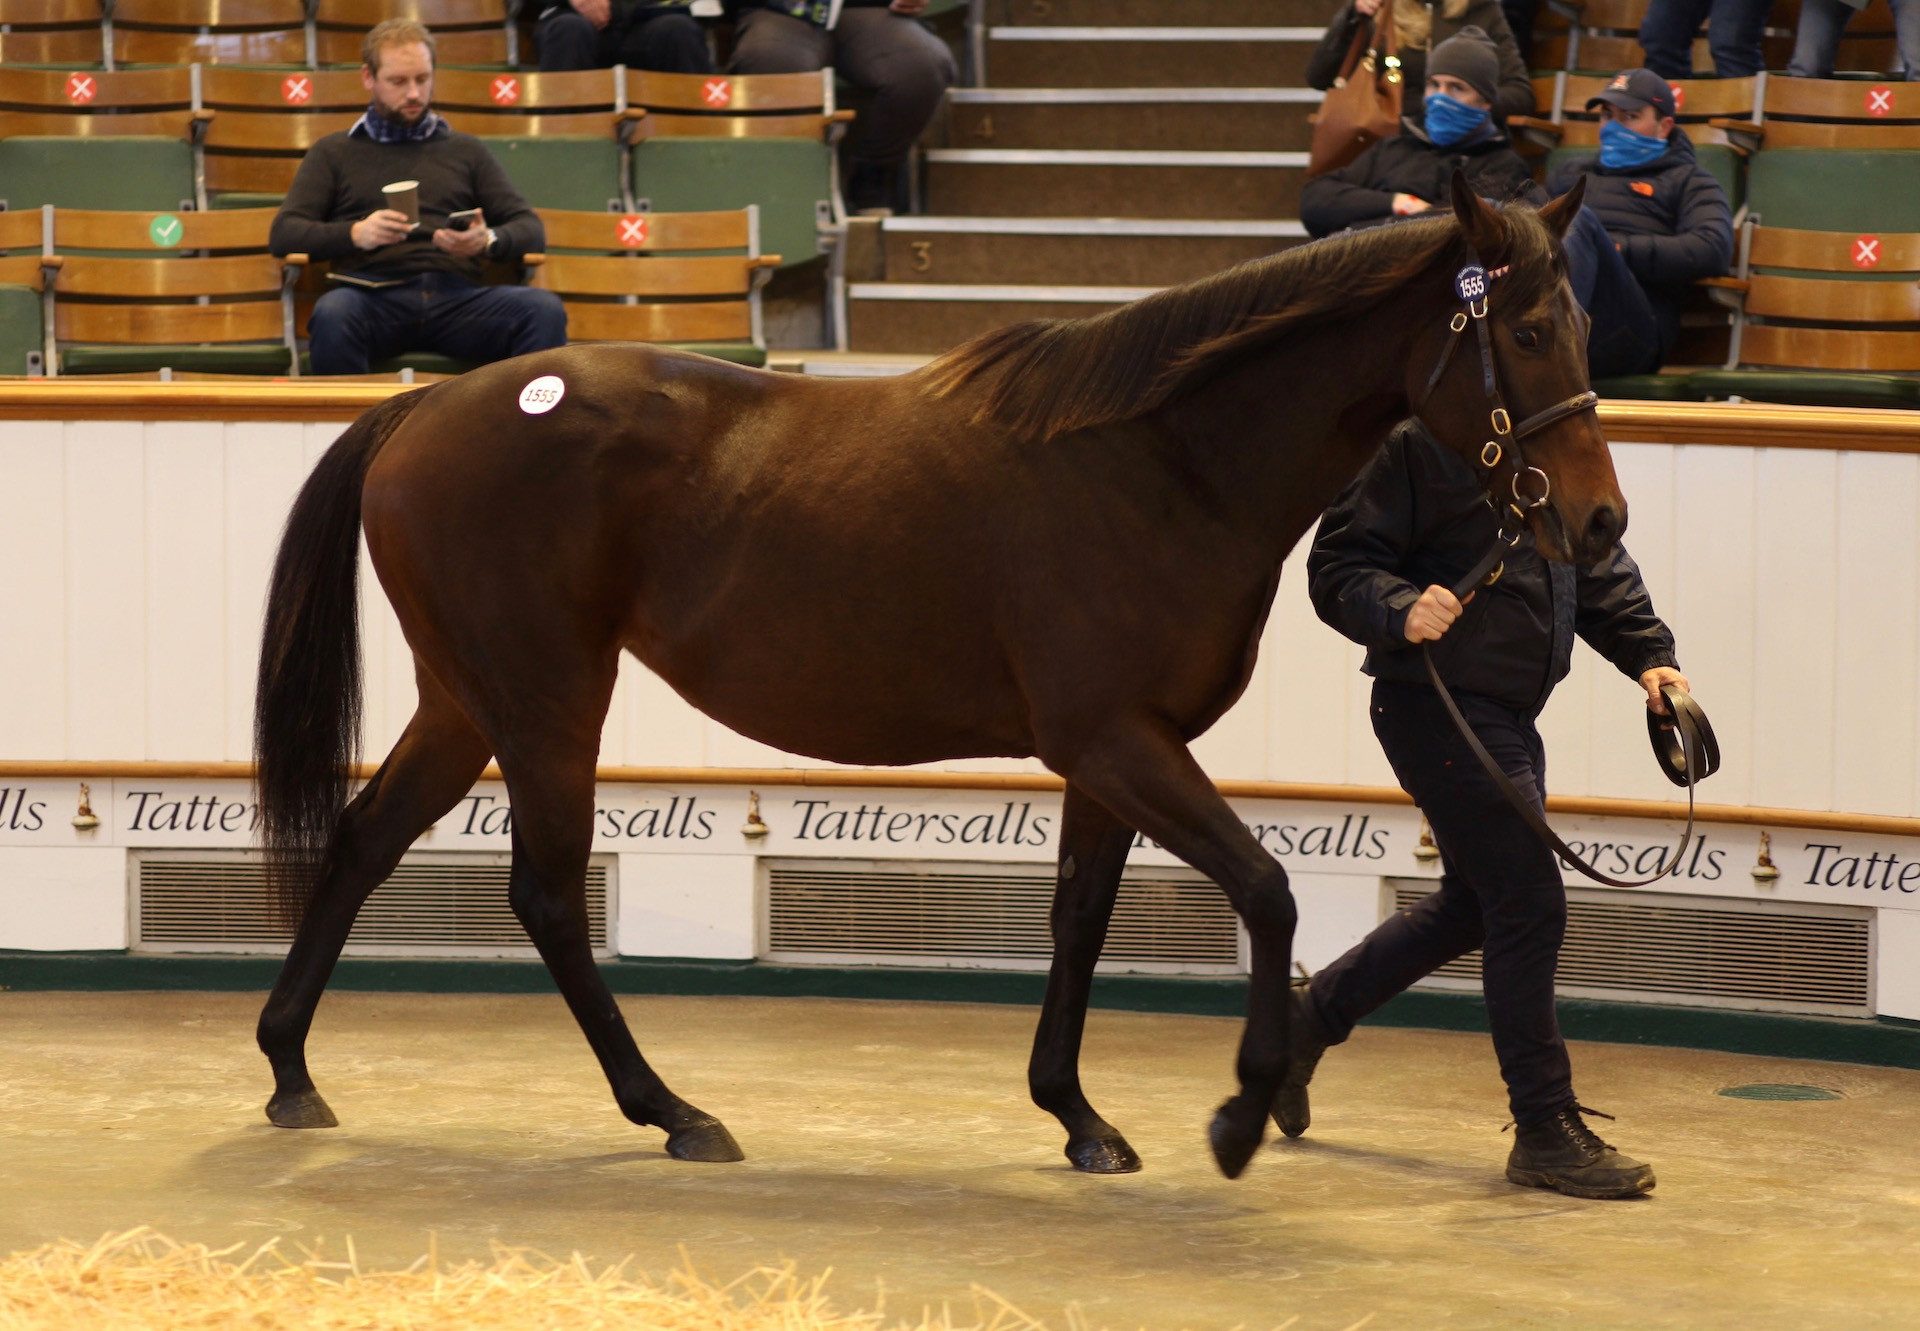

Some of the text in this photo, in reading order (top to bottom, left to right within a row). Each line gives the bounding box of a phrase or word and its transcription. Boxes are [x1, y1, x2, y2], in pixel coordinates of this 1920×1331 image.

[911, 241, 932, 271] 3
[1460, 275, 1485, 298] 1555
[525, 389, 558, 403] 1555
[0, 787, 47, 830] lls
[793, 799, 1050, 846] Tattersalls
